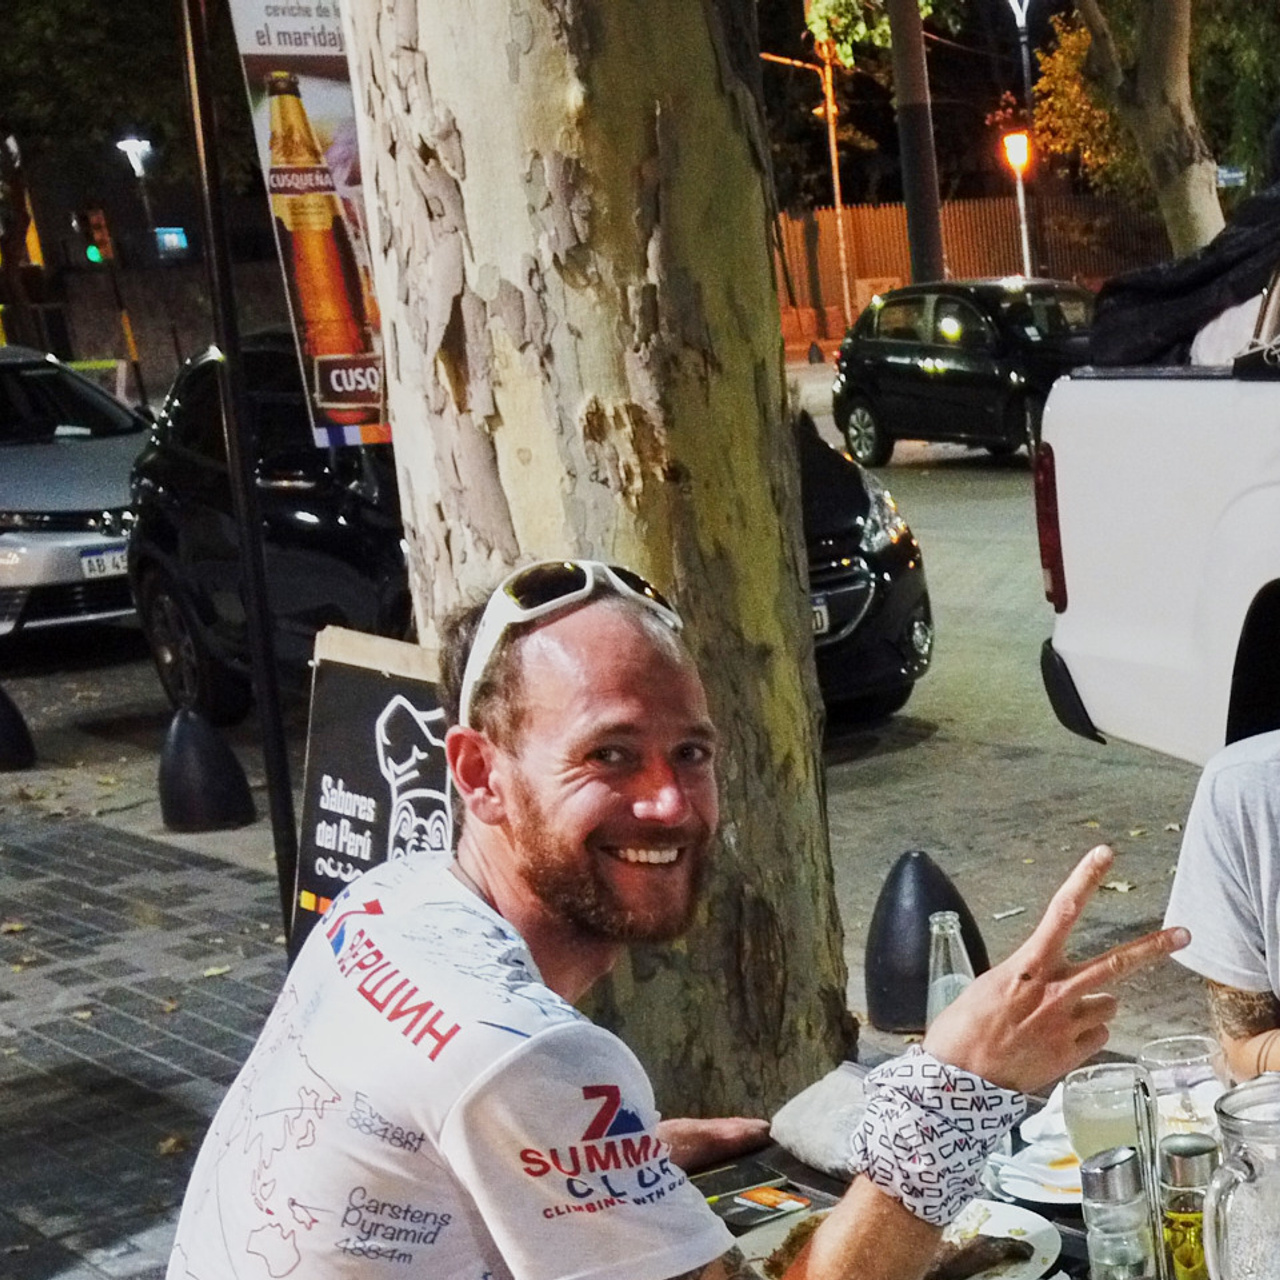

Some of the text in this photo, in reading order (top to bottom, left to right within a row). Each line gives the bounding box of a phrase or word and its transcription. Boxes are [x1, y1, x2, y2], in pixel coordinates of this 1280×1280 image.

[256, 23, 272, 46] el
[330, 366, 382, 393] CUSQ
[319, 774, 376, 823] Sabores
[315, 818, 372, 860] del Perú
[581, 1085, 621, 1142] 7
[340, 1206, 442, 1246] Pyramid
[348, 1186, 452, 1227] Carstens
